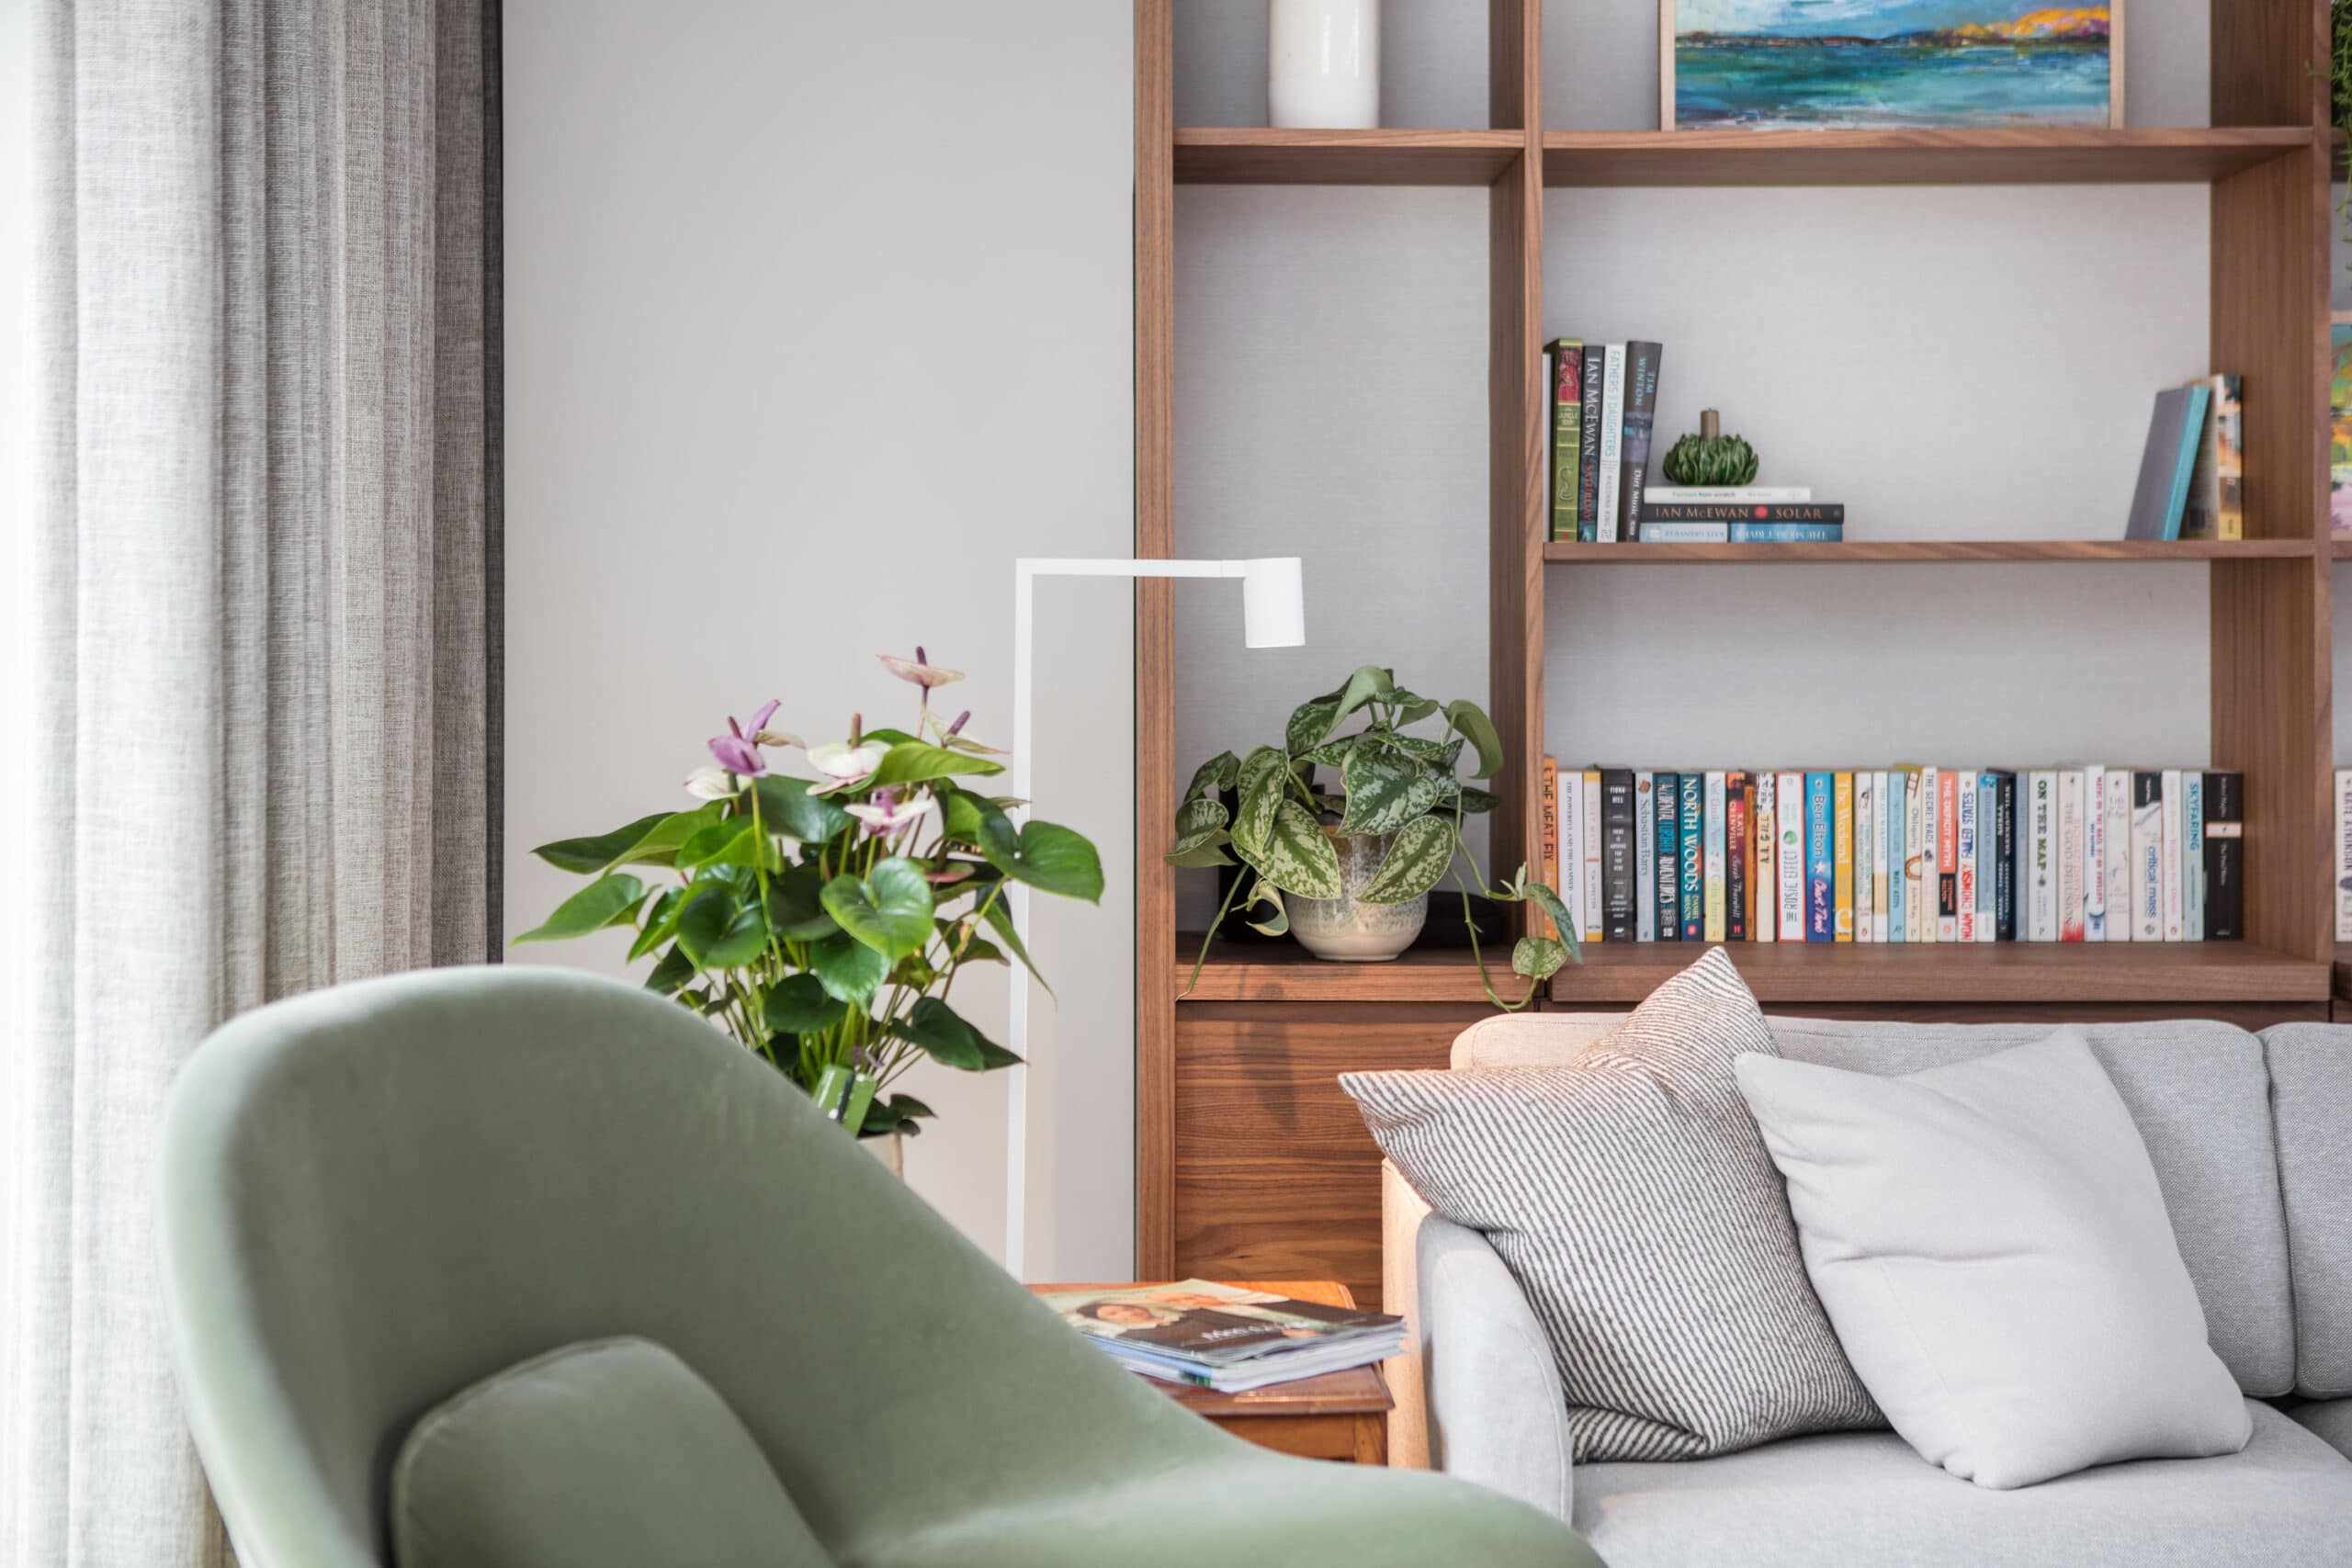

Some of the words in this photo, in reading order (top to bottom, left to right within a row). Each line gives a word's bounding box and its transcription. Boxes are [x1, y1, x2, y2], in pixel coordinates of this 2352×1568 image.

[1587, 357, 1600, 383] IAN
[1609, 351, 1620, 394] FATHERS
[1634, 355, 1645, 406] WINTON
[1646, 370, 1655, 393] TIM
[1605, 403, 1618, 457] DAUGHTERS
[1584, 463, 1595, 520] SATURDAY
[1634, 470, 1642, 487] Dirt
[1631, 491, 1640, 517] Music
[1656, 506, 1681, 518] IAN
[1775, 506, 1822, 519] SOLAR
[1837, 781, 1849, 804] The
[1925, 774, 1933, 787] THE
[1943, 779, 1952, 797] THE
[2037, 780, 2047, 800] ON
[1683, 778, 1698, 829] NORTH
[1814, 794, 1825, 820] Ben
[1925, 791, 1933, 820] SECRET
[1943, 800, 1952, 836] DEFICIT
[1962, 793, 1973, 824] STATES
[2064, 803, 2073, 826] THE
[2189, 783, 2199, 851] SKYFARING
[1544, 806, 1554, 836] MEAT
[1641, 799, 1651, 848] Sebastian
[1910, 808, 1919, 849] Obliquity
[2037, 804, 2047, 834] THE
[1814, 823, 1825, 858] Elton
[1837, 808, 1849, 863] Weekend
[1925, 824, 1933, 844] RACE
[1962, 828, 1973, 859] FAILED
[2064, 830, 2073, 859] GOD
[1544, 843, 1554, 861] FIX
[1639, 850, 1650, 876] Barry
[1683, 834, 1698, 891] WOODS
[1783, 850, 1797, 879] EFFECT
[1943, 839, 1952, 867] MYTH
[2037, 838, 2047, 871] MAP
[2147, 845, 2159, 884] critical
[1732, 855, 1742, 879] Sarah
[1783, 882, 1797, 910] ROSIE
[1962, 864, 1973, 908] CHOMSKY
[2064, 863, 2073, 924] DELUSION
[2148, 887, 2158, 919] mass
[1962, 912, 1973, 941] NOAM
